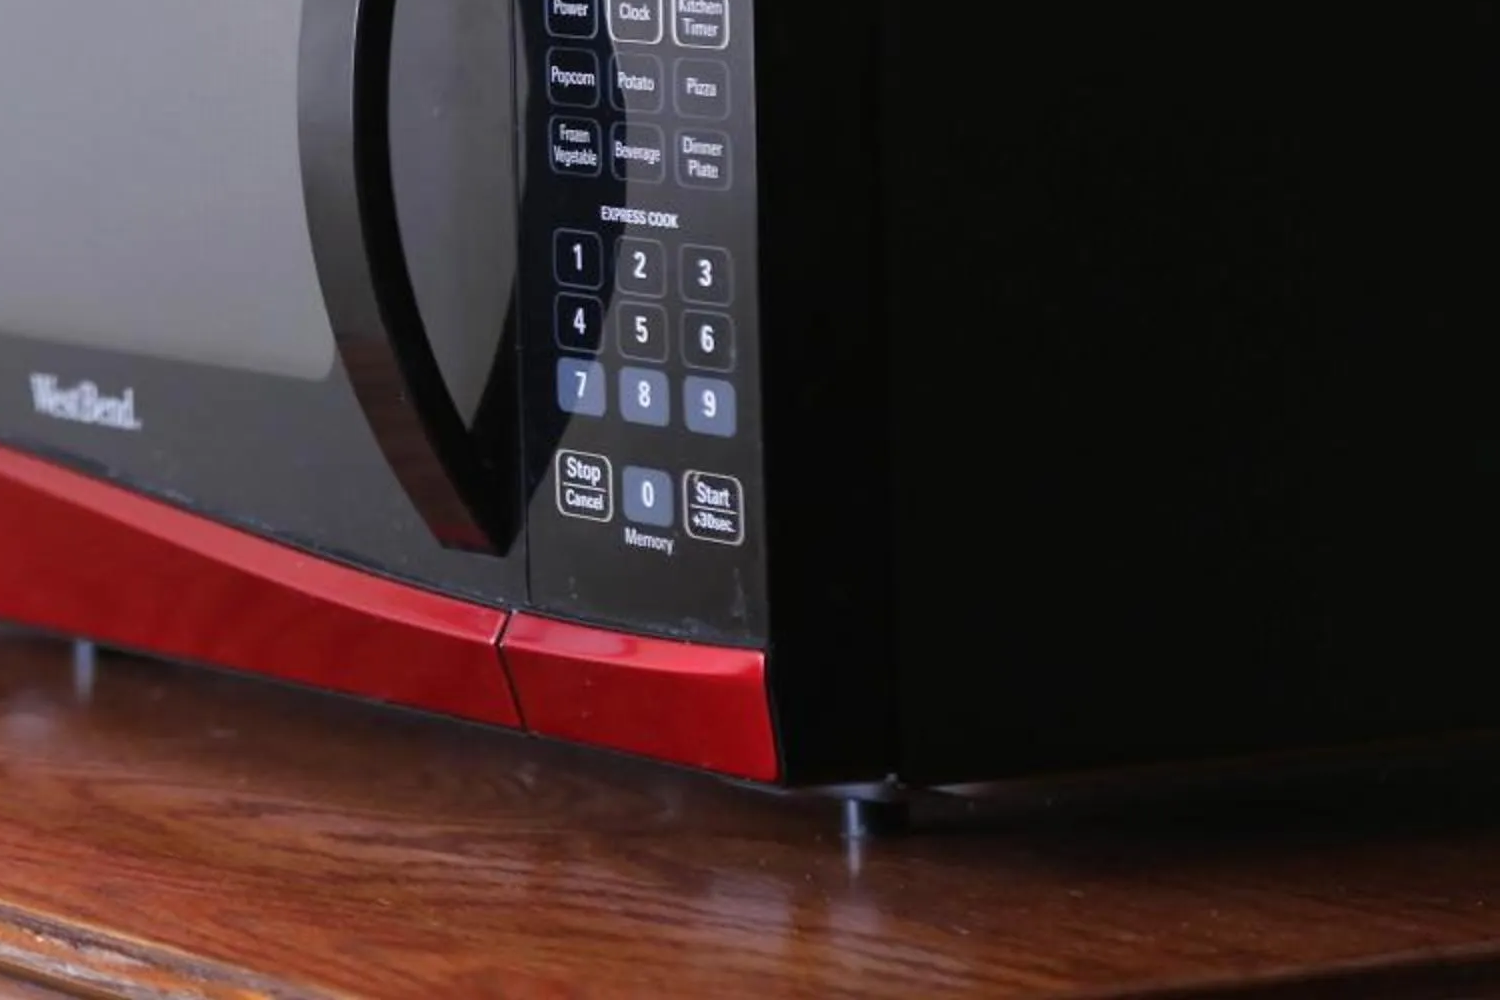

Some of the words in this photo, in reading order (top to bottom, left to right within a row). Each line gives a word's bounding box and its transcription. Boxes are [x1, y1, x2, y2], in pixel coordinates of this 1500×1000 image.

[619, 3, 650, 21] Clock
[681, 18, 719, 36] Timer
[551, 66, 595, 87] Popcorn
[617, 72, 655, 91] Potato
[686, 78, 717, 97] Pizza
[559, 124, 590, 143] Frozen
[682, 137, 723, 156] Dinner
[553, 146, 597, 167] Vegetable
[615, 141, 660, 164] Beverage
[688, 160, 719, 179] Plate
[601, 206, 646, 225] EXPRESS
[648, 212, 679, 228] COOK
[572, 243, 583, 271] 1
[633, 251, 647, 279] 2
[698, 259, 713, 287] 3
[573, 307, 587, 335] 4
[635, 316, 648, 343] 5
[700, 325, 715, 353] 6
[575, 371, 587, 398] 7
[638, 380, 651, 408] 8
[703, 389, 717, 418] 9
[566, 456, 601, 487] Stop
[565, 489, 604, 511] Cancel
[641, 480, 655, 508] 0
[696, 482, 730, 508] Start
[624, 527, 674, 555] Memory
